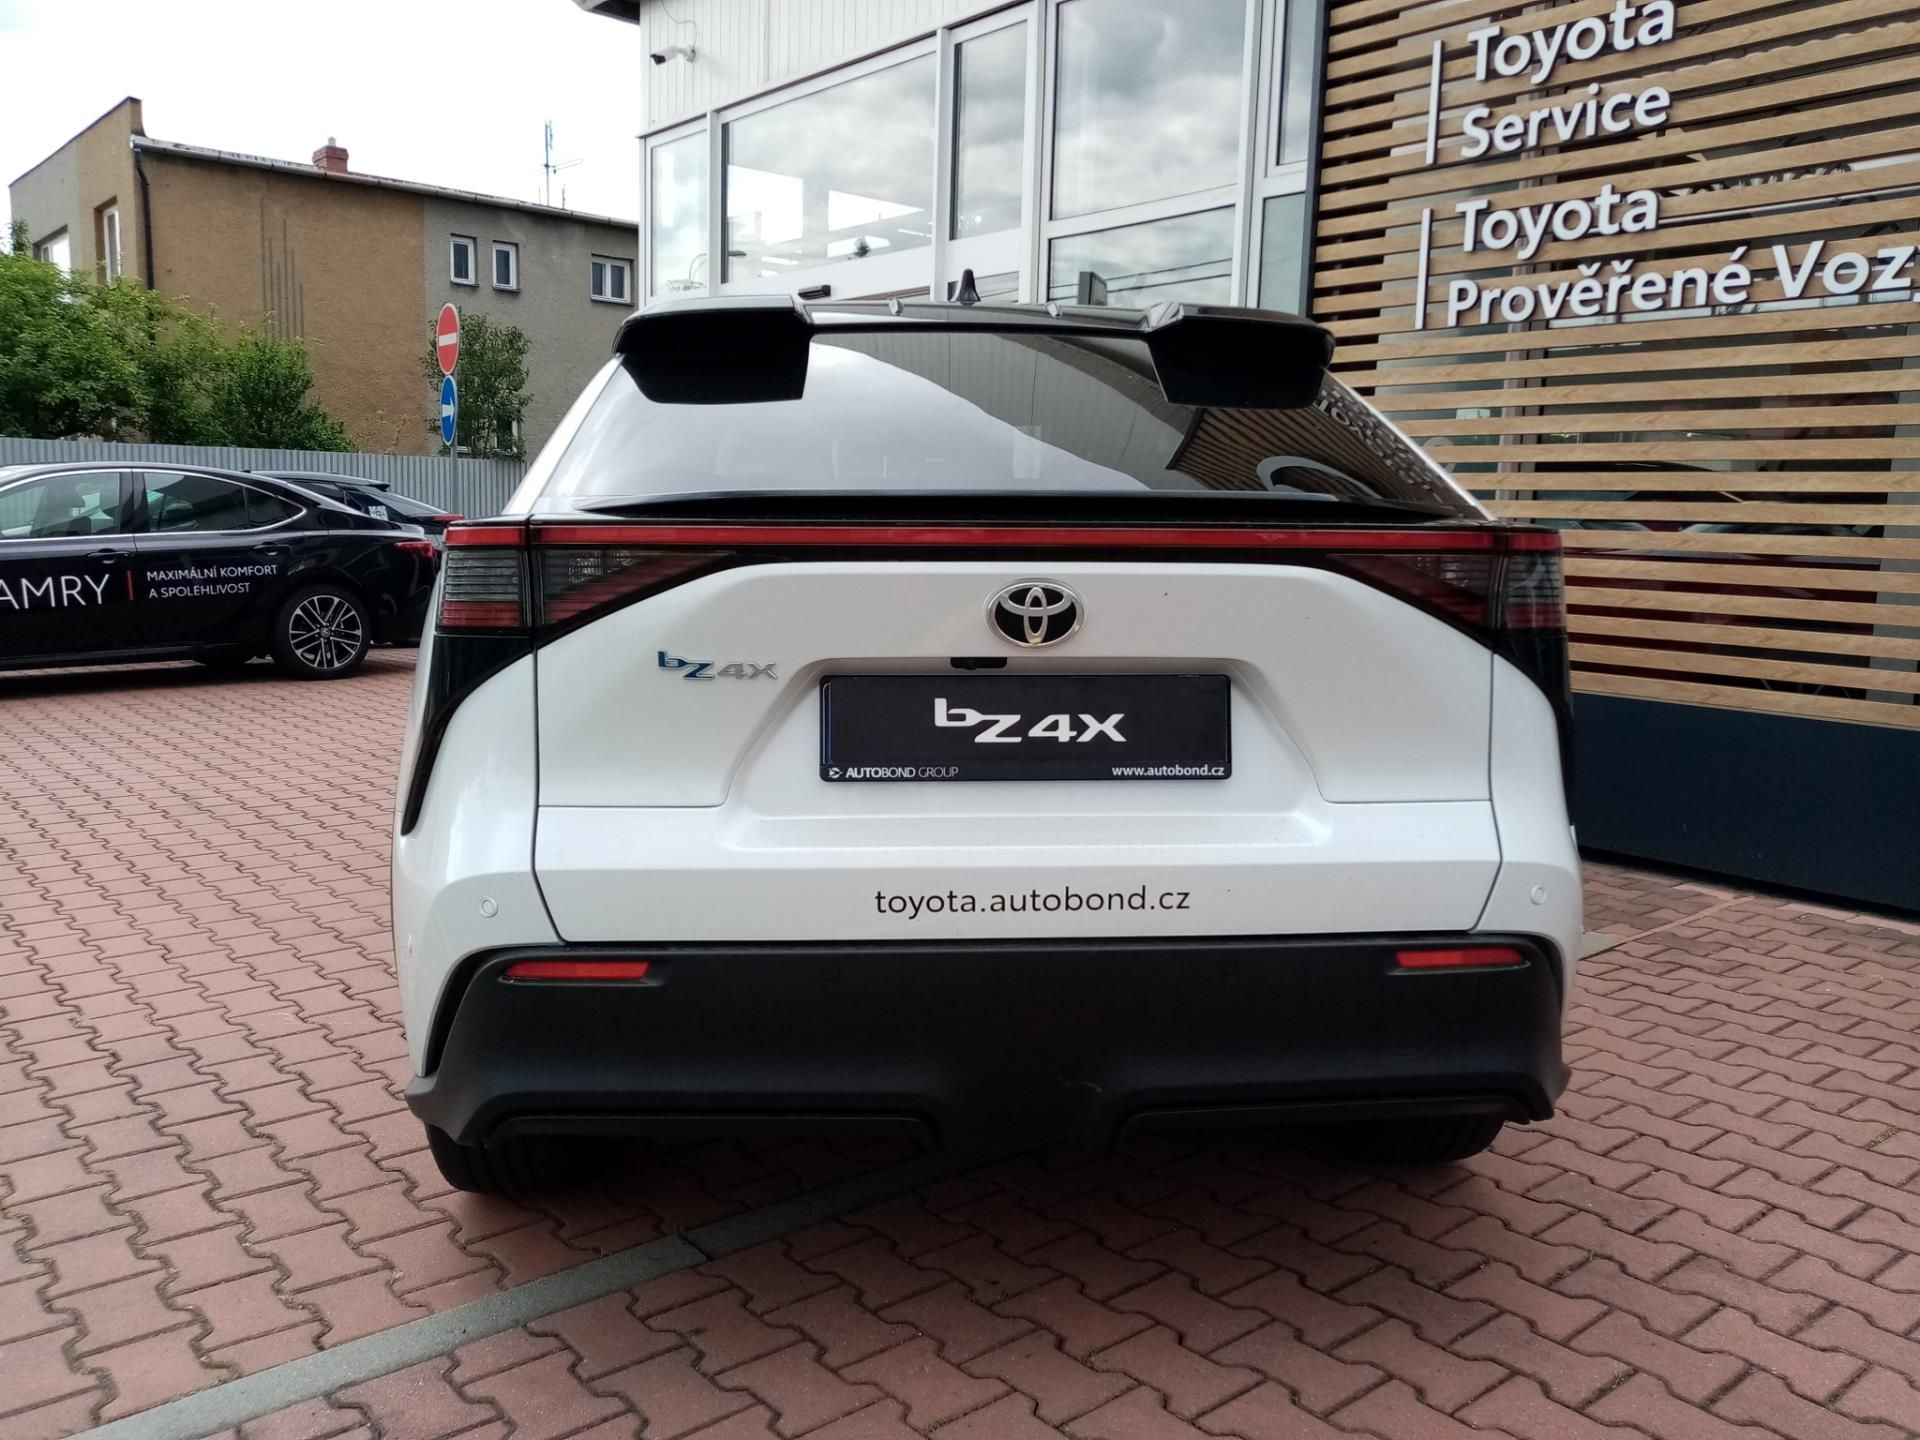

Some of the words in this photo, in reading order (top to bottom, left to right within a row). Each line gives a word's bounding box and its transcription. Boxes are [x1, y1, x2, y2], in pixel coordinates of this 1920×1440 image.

[1467, 0, 1675, 84] Toyota
[1461, 83, 1671, 158] Service
[1455, 184, 1660, 260] Toyota
[1446, 246, 1751, 327] Prověřené
[1772, 240, 1920, 303] Voz
[147, 565, 218, 581] MAXIMÁLNÍ
[220, 565, 278, 577] KOMFORT
[149, 588, 158, 599] A
[161, 583, 250, 597] SPOLEHLIVOST
[845, 767, 916, 778] AUTOBOND
[918, 767, 959, 777] GROUP
[1112, 764, 1225, 777] www.autobond.cz
[875, 885, 1190, 920] toyota.autobond.cz
